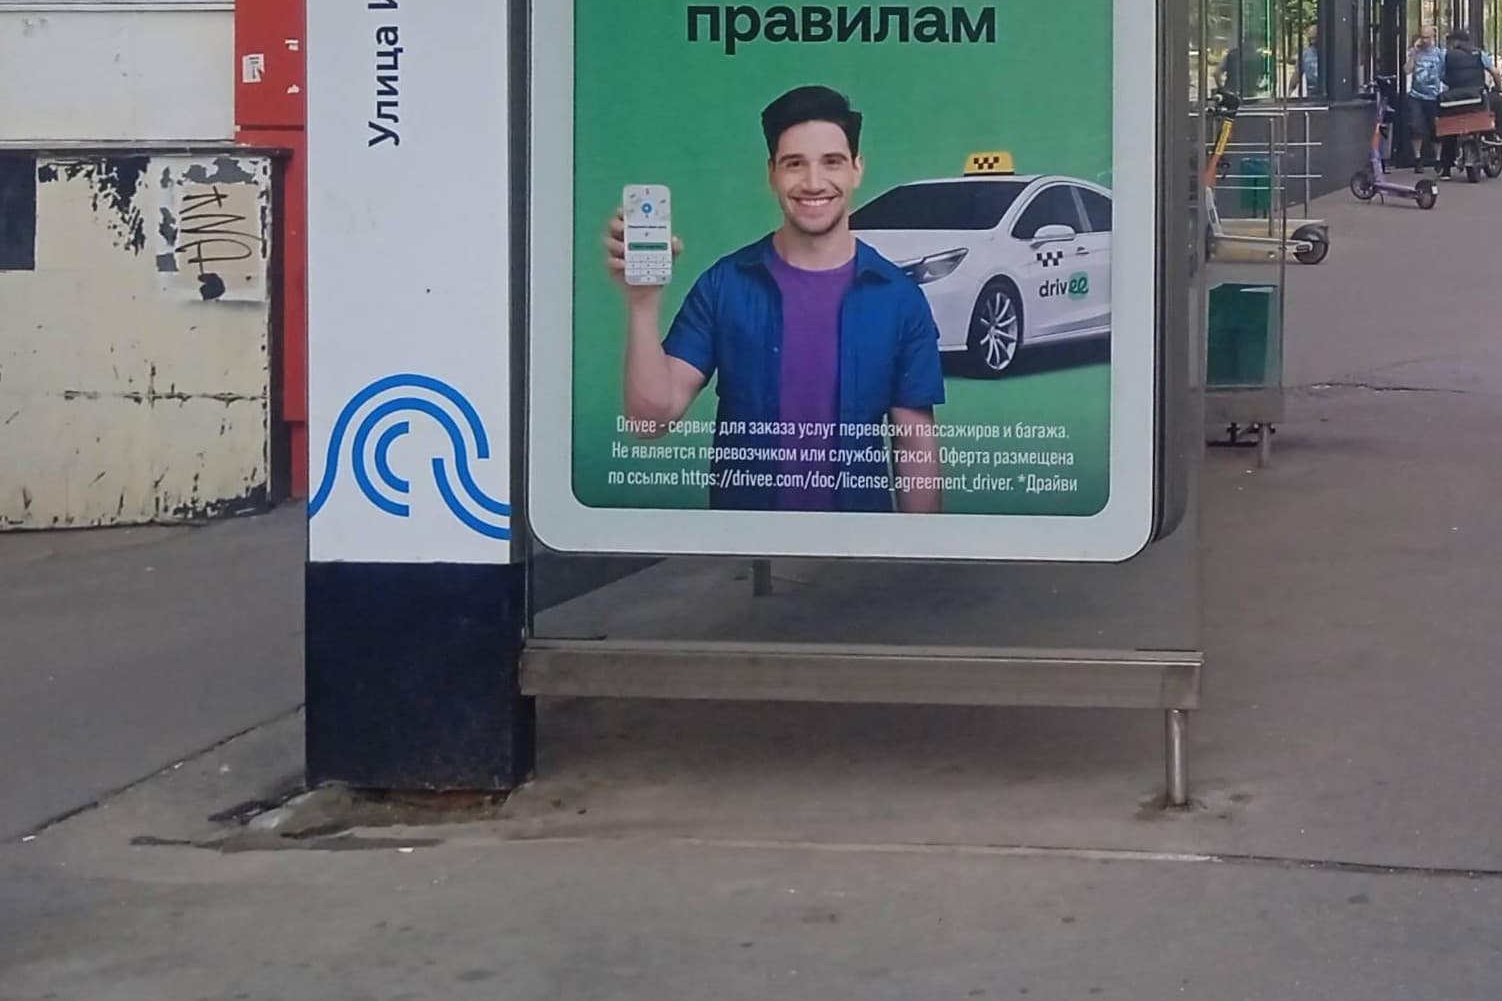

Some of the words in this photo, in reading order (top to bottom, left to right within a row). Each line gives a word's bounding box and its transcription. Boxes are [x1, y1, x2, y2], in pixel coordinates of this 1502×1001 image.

[686, 4, 997, 56] правилам
[367, 25, 404, 148] Улица
[1038, 274, 1090, 298] drivee
[616, 415, 657, 434] Drivee
[668, 419, 717, 439] сервис
[719, 419, 747, 436] для
[748, 420, 796, 436] заказа
[798, 421, 836, 440] услуг
[839, 422, 913, 441] перевозки
[915, 422, 1001, 442] пассажиров
[1003, 424, 1012, 439] и
[1015, 421, 1071, 440] багажа.
[611, 441, 628, 459] Не
[631, 445, 696, 460] является
[698, 446, 797, 464] перевозчиком
[800, 447, 826, 462] или
[829, 445, 890, 466] службой
[893, 448, 937, 464] такси.
[939, 447, 990, 467] Оферта
[993, 450, 1074, 467] размещена
[608, 470, 625, 485] по
[627, 470, 679, 486] ссылке
[681, 469, 1015, 493] https://drivee.com/doc/license_agreement_driver.
